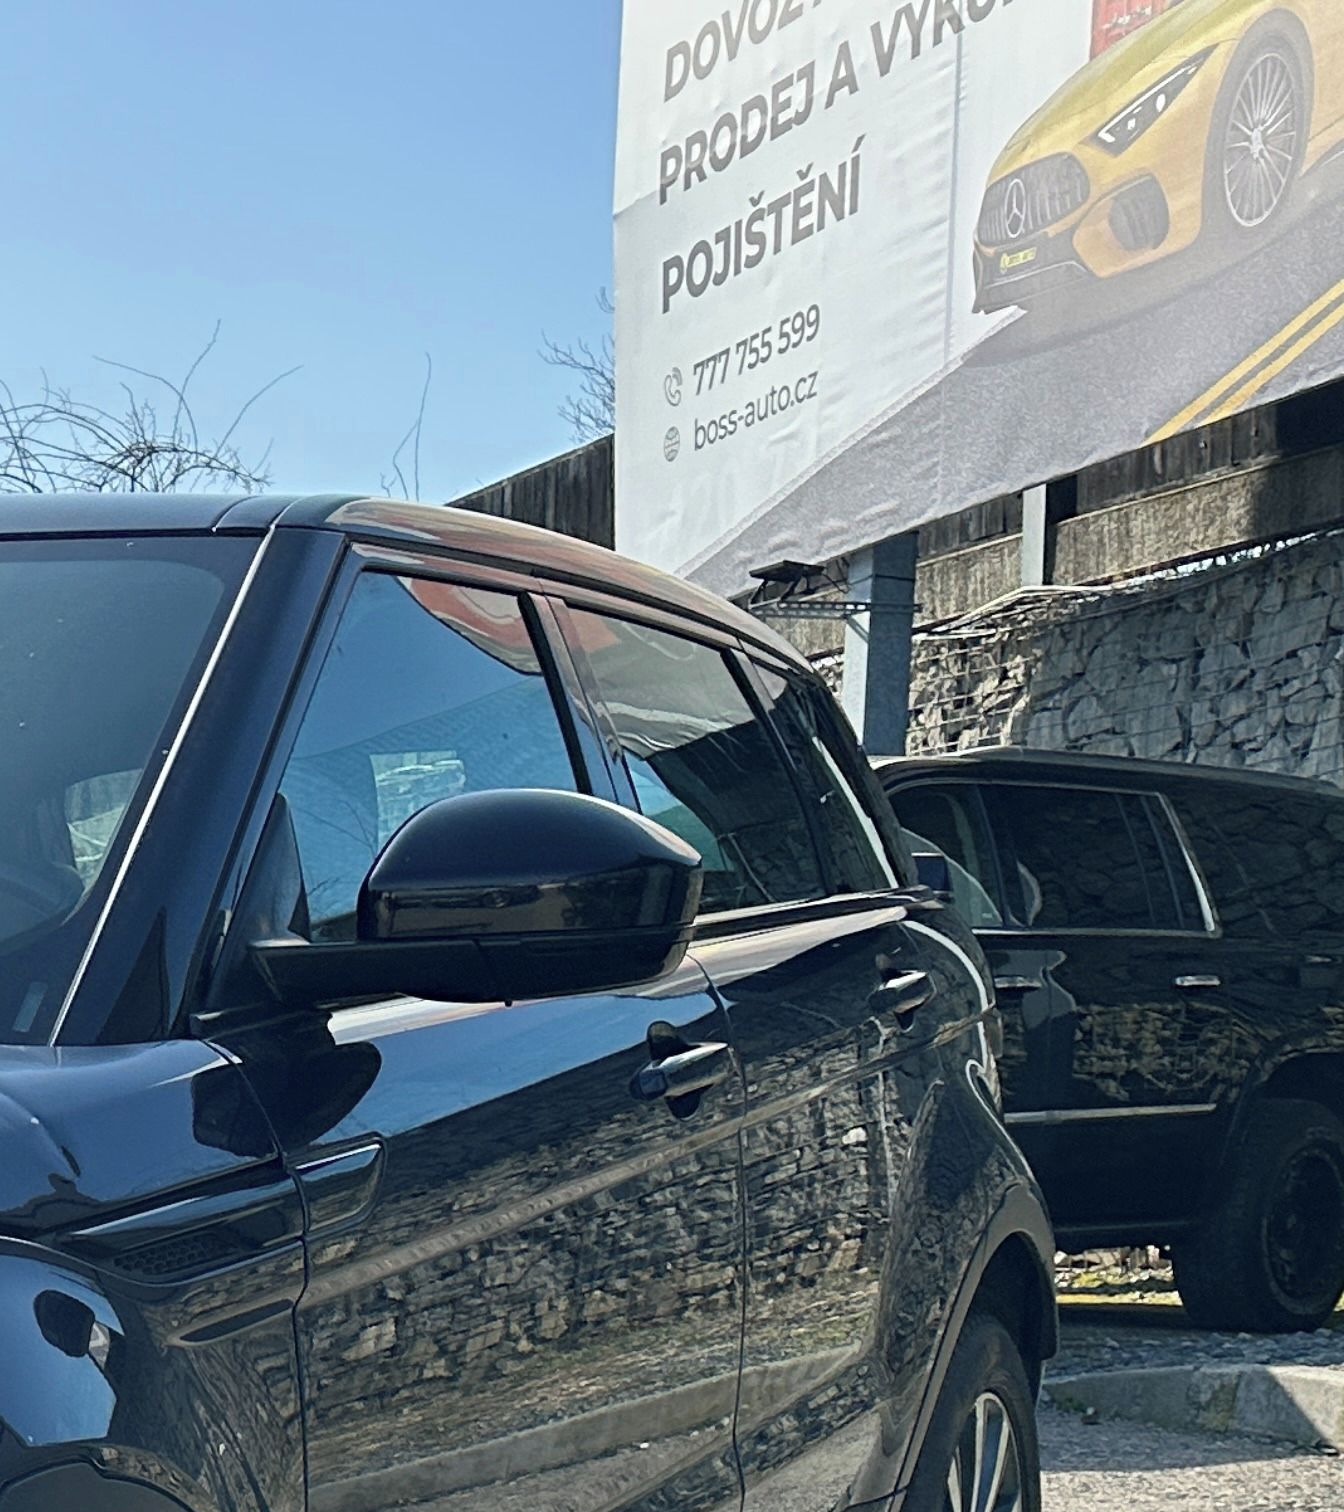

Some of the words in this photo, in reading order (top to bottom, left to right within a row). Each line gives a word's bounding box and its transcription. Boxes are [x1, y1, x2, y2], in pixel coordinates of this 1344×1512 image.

[659, 60, 816, 206] PRODEJ
[824, 40, 860, 110] A
[870, 0, 1014, 78] VYK
[662, 134, 867, 315] POJIŠTĚNÍ
[693, 347, 731, 396] 777
[736, 326, 772, 376] 755
[777, 304, 820, 354] 599
[694, 371, 819, 451] boss-auto.cz
